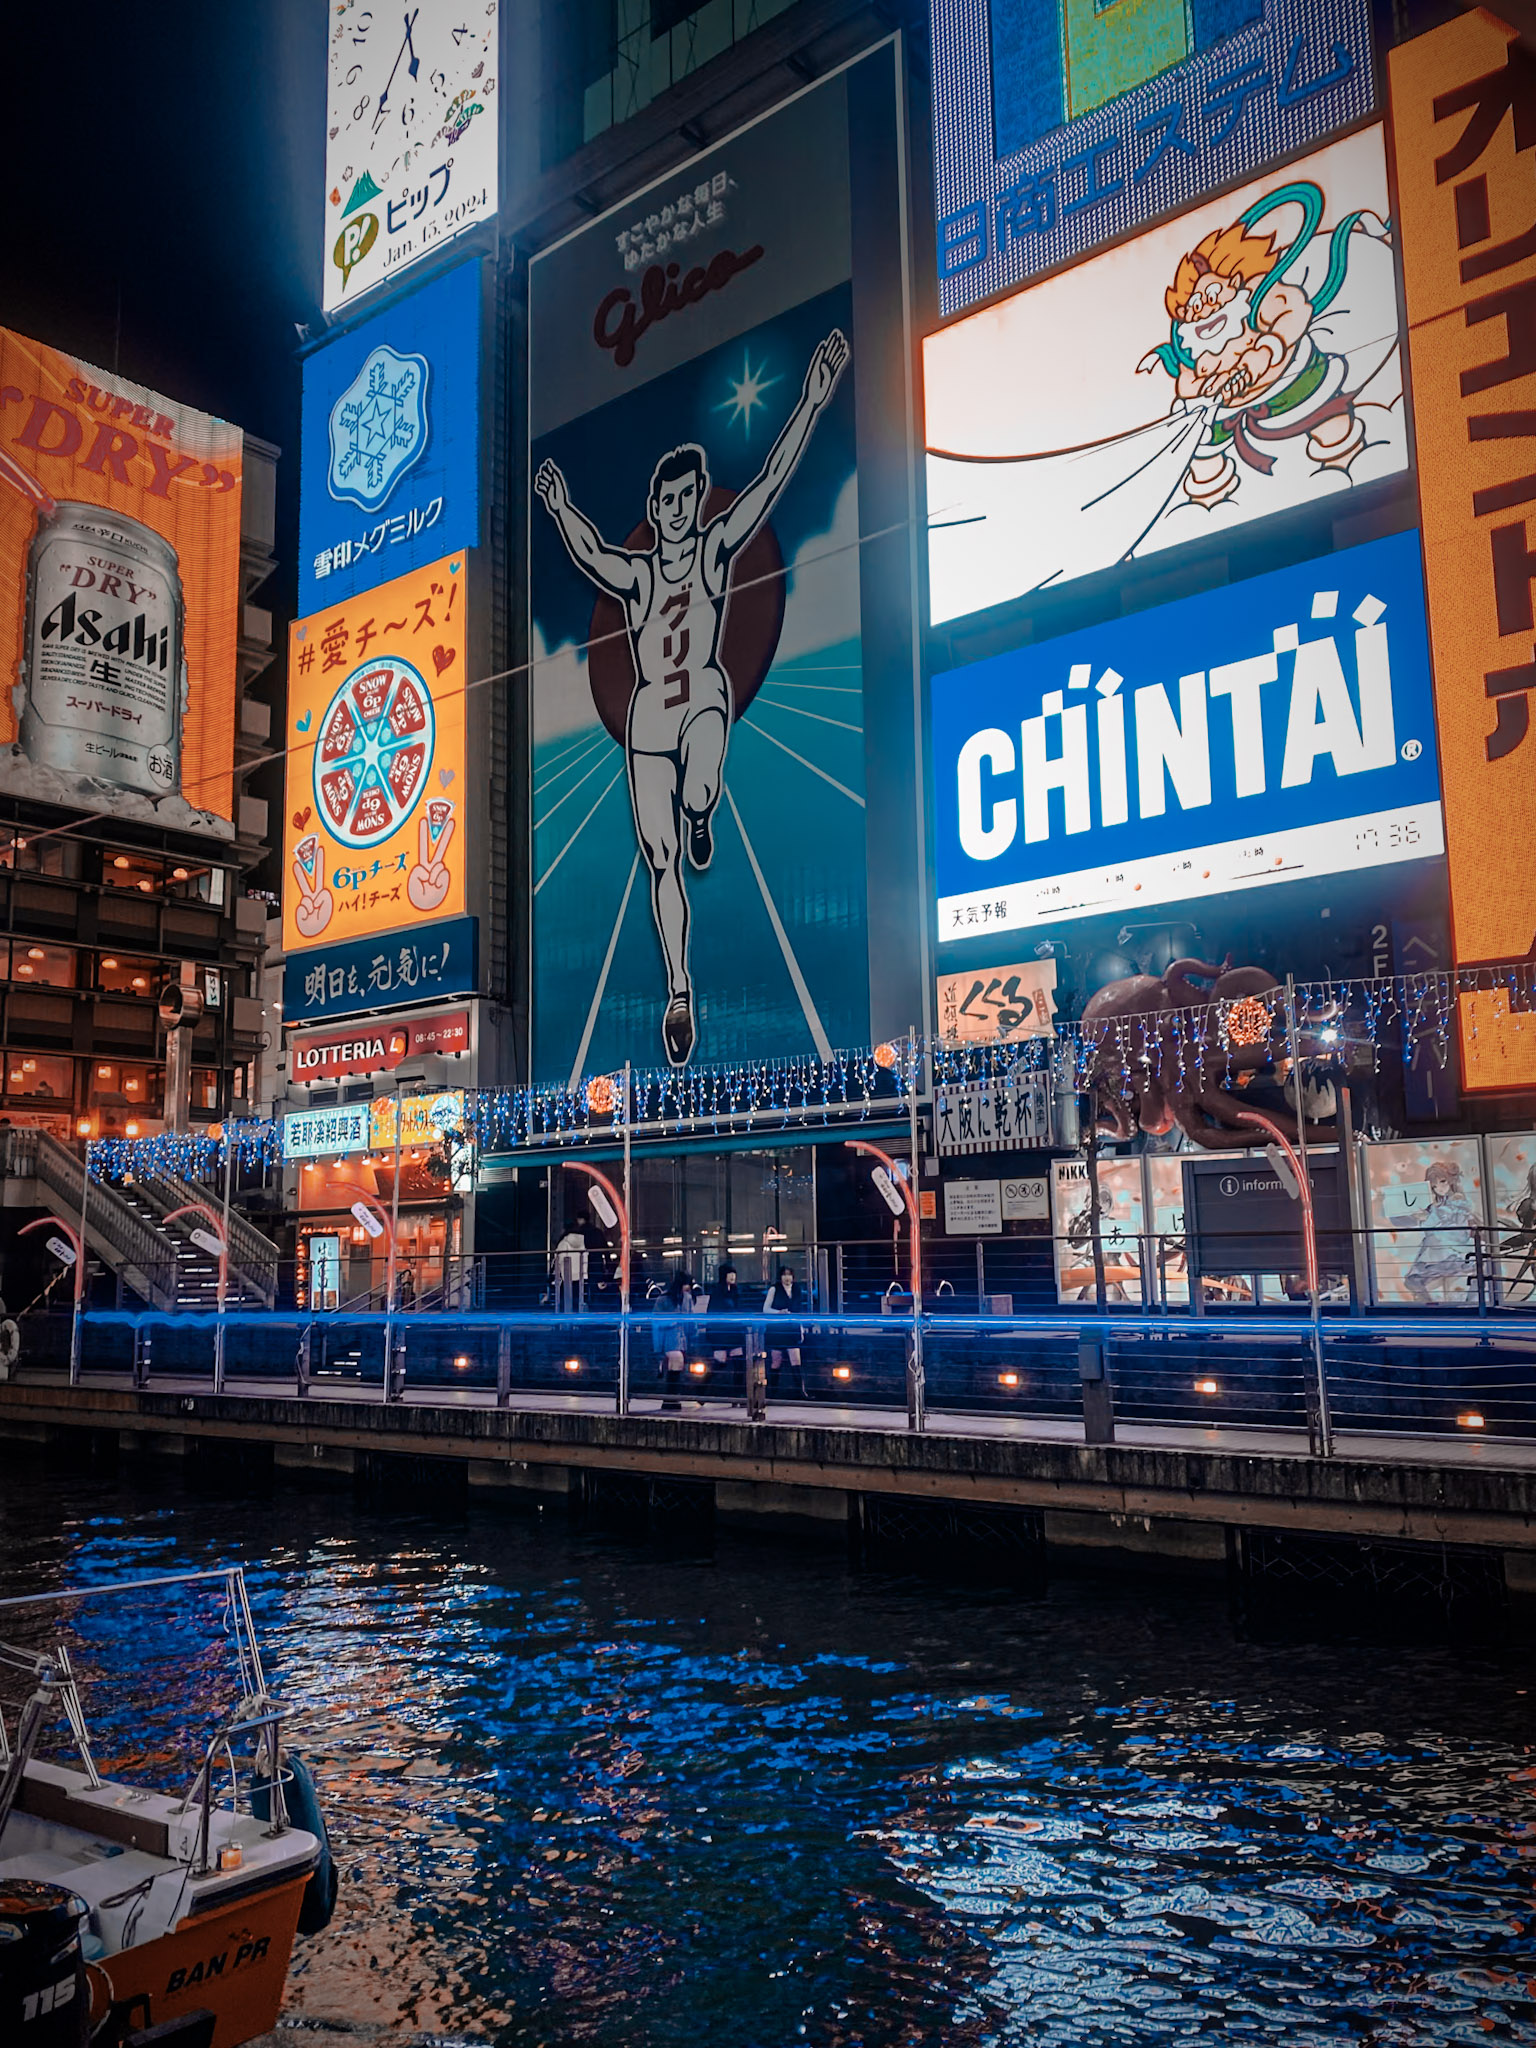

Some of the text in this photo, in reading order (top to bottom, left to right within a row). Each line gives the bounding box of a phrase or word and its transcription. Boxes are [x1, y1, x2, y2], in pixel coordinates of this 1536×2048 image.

[451, 23, 468, 46] 4
[346, 64, 363, 85] 9
[353, 94, 370, 121] 8
[937, 31, 1357, 279] 日商エステム
[387, 157, 454, 235] ピップ
[445, 187, 488, 228] 2024
[616, 170, 738, 253] すこやかな毎日、
[624, 201, 725, 271] ゆたかな人生
[594, 244, 764, 367] Glico
[64, 377, 175, 440] SUPER
[313, 497, 443, 579] 雪印メグミルク
[87, 555, 135, 579] SUPER
[41, 591, 168, 672] Asahi
[659, 581, 693, 710] グリコ
[90, 659, 121, 687] 生
[359, 674, 387, 694] SNOW
[66, 696, 142, 725] スーパードライ
[402, 686, 423, 723] SNOW
[957, 590, 1397, 861] CHINTAI
[85, 742, 119, 759] 生ビール
[150, 755, 173, 780] お酒
[401, 753, 421, 798] SNOW
[323, 782, 341, 817] SNOW
[356, 814, 385, 832] SNOW
[952, 901, 1007, 927] 天気予報
[959, 975, 1033, 1032] くくる
[297, 1038, 385, 1069] LOTTERIA
[940, 1087, 1032, 1143] 大阪に乾杯
[1059, 1165, 1089, 1180] NIKK
[166, 1952, 228, 1994] BAN
[22, 1973, 76, 2021] 115
